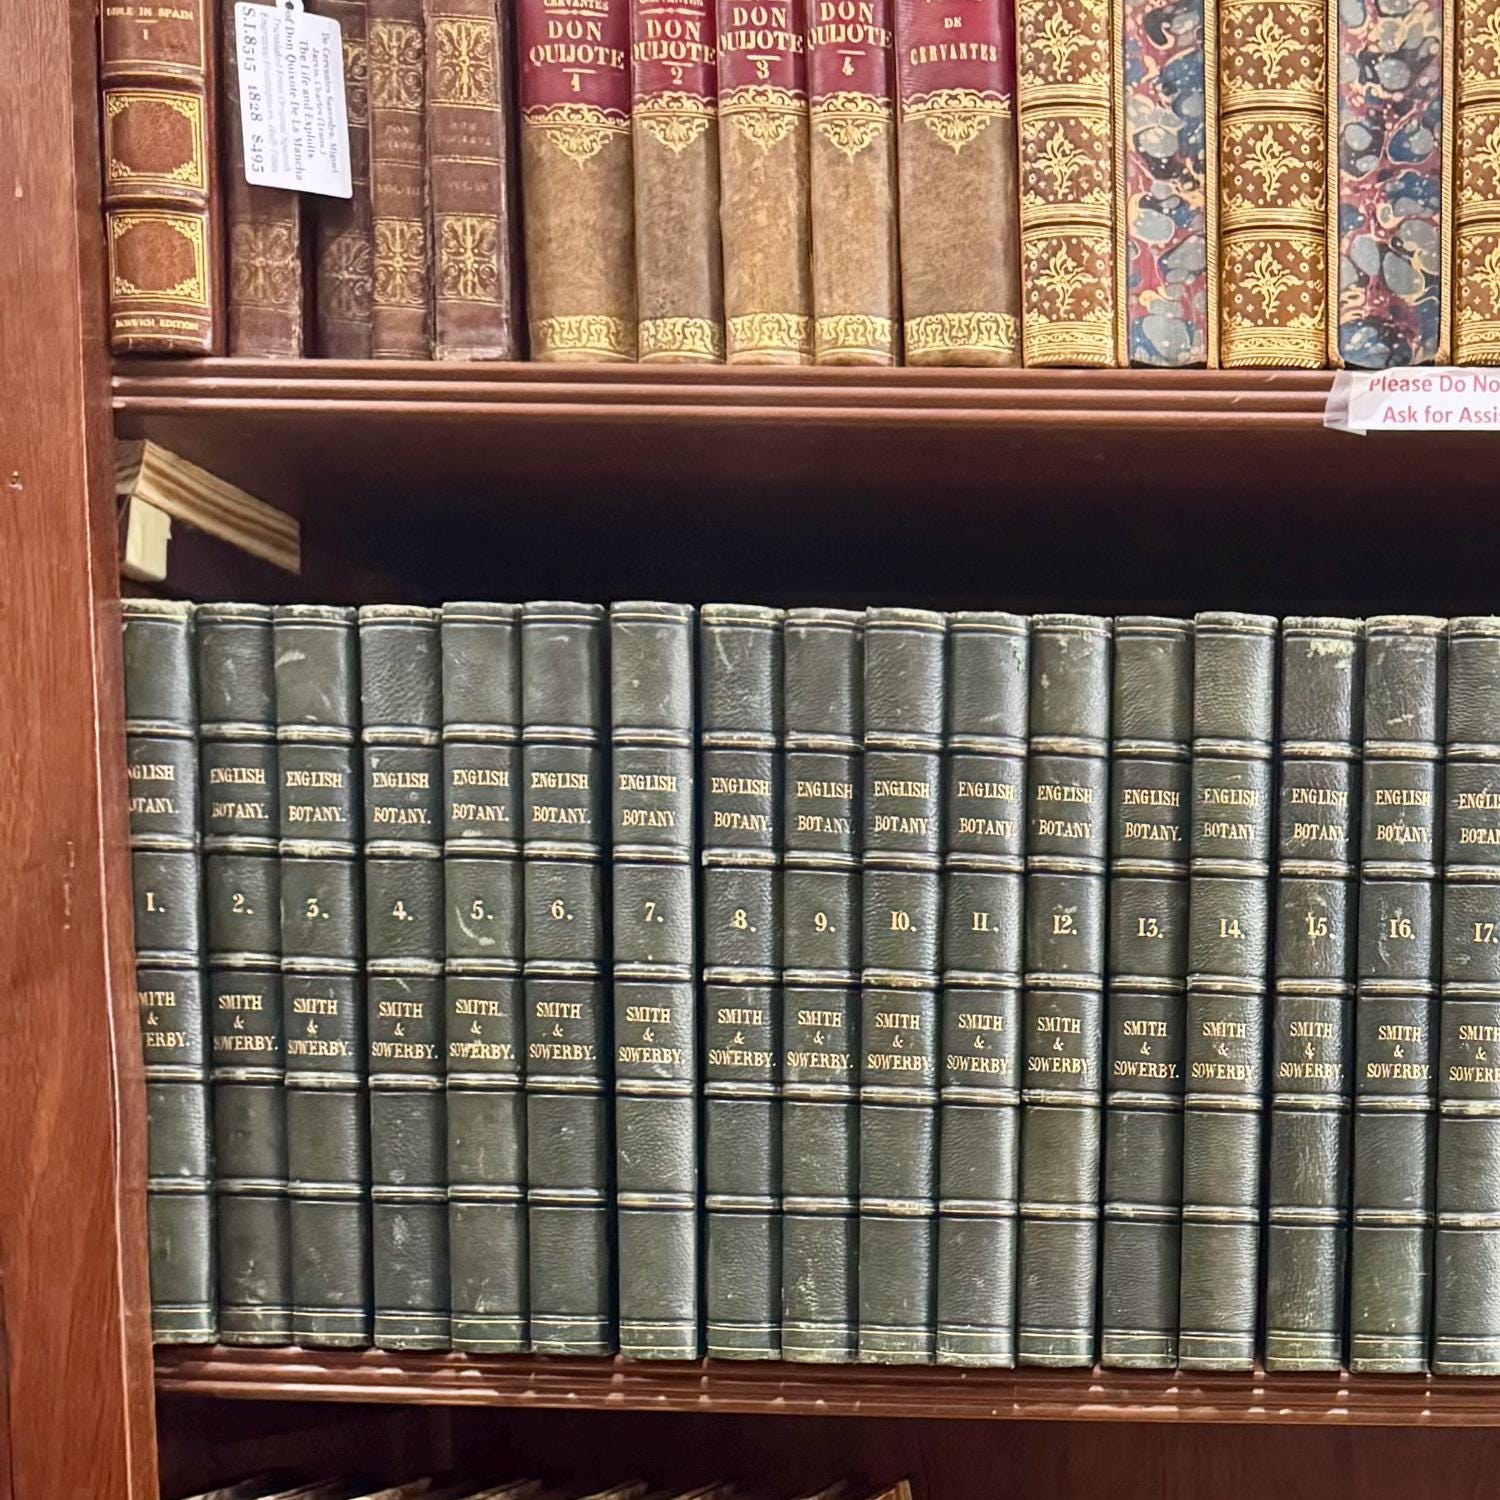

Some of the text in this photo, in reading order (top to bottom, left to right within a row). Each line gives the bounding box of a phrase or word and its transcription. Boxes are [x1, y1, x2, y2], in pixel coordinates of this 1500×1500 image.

[158, 8, 194, 21] SPAIN
[733, 6, 787, 28] DON
[820, 1, 875, 24] DON
[548, 20, 602, 42] DON
[646, 19, 701, 42] DON
[943, 16, 963, 29] DE
[299, 40, 309, 60] The
[529, 43, 625, 70] QUIJOTE
[910, 42, 998, 66] CERVANTES
[670, 66, 683, 85] 2
[756, 60, 770, 80] 3
[841, 56, 855, 76] 4
[571, 73, 581, 92] 1
[247, 84, 264, 122] 1828
[284, 25, 295, 49] Don
[293, 137, 307, 181] Mancha
[302, 88, 313, 109] and
[1369, 374, 1433, 393] Please
[1439, 375, 1466, 393] Do
[1382, 405, 1417, 424] Ask
[1424, 404, 1453, 424] for
[372, 772, 429, 789] ENGLISH
[530, 772, 589, 790] ENGLISH
[1122, 789, 1180, 807] ENGLISH
[373, 807, 432, 825] BOTANY.
[532, 807, 591, 825] BOTANY.
[1125, 822, 1182, 842] BOTANY.
[392, 901, 414, 921] 4.
[551, 900, 574, 921] 6.
[1137, 917, 1164, 938] 13.
[378, 1002, 424, 1019] SMITH
[536, 1001, 582, 1019] SMITH
[394, 1023, 405, 1037] &
[552, 1023, 564, 1037] &
[1123, 1021, 1167, 1037] SMITH
[371, 1042, 439, 1060] SOWERBY.
[529, 1043, 596, 1061] SOWERBY.
[1140, 1041, 1151, 1055] &
[1114, 1061, 1180, 1080] SOWERBY.
